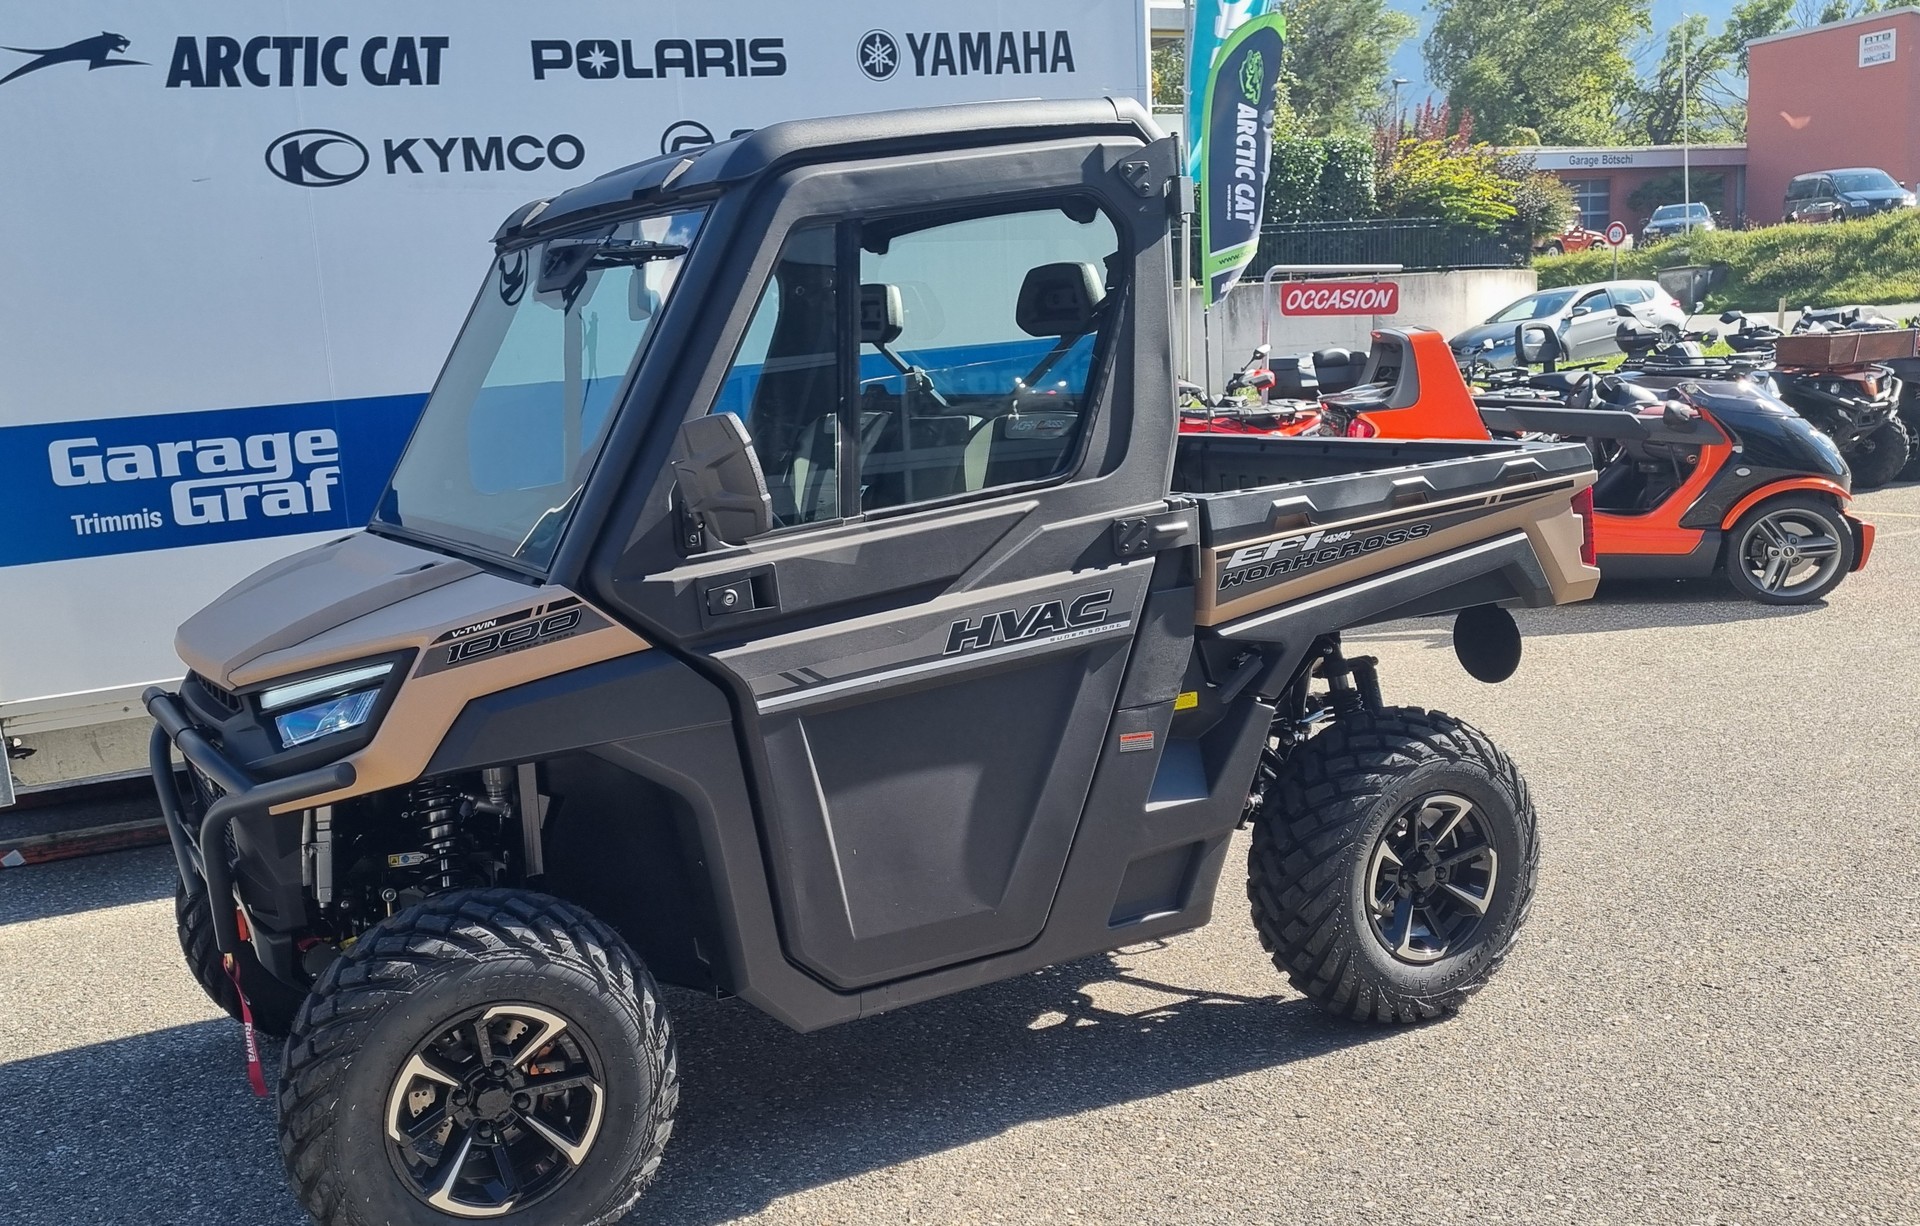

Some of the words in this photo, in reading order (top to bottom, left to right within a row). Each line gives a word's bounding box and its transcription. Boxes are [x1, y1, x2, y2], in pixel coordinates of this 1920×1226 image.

[165, 36, 349, 88] ARCTIC
[360, 36, 450, 87] CAT
[531, 38, 787, 80] POLARIS
[905, 30, 1076, 77] YAMAHA
[384, 133, 586, 175] KYMCO
[1235, 102, 1258, 181] ARCTIC
[1569, 155, 1599, 167] Garage
[1602, 154, 1634, 165] Bötschi
[1235, 183, 1257, 224] CAT
[1286, 288, 1394, 311] OCCASION
[48, 428, 339, 487] Garage
[171, 466, 341, 526] Graf
[71, 508, 163, 536] Trimmis
[1217, 523, 1432, 591] WORKCROSS
[1224, 530, 1326, 570] EFI
[446, 608, 582, 665] 1000
[451, 619, 497, 638] V-TWIN
[942, 588, 1113, 656] HVAC
[244, 1022, 256, 1063] Runva
